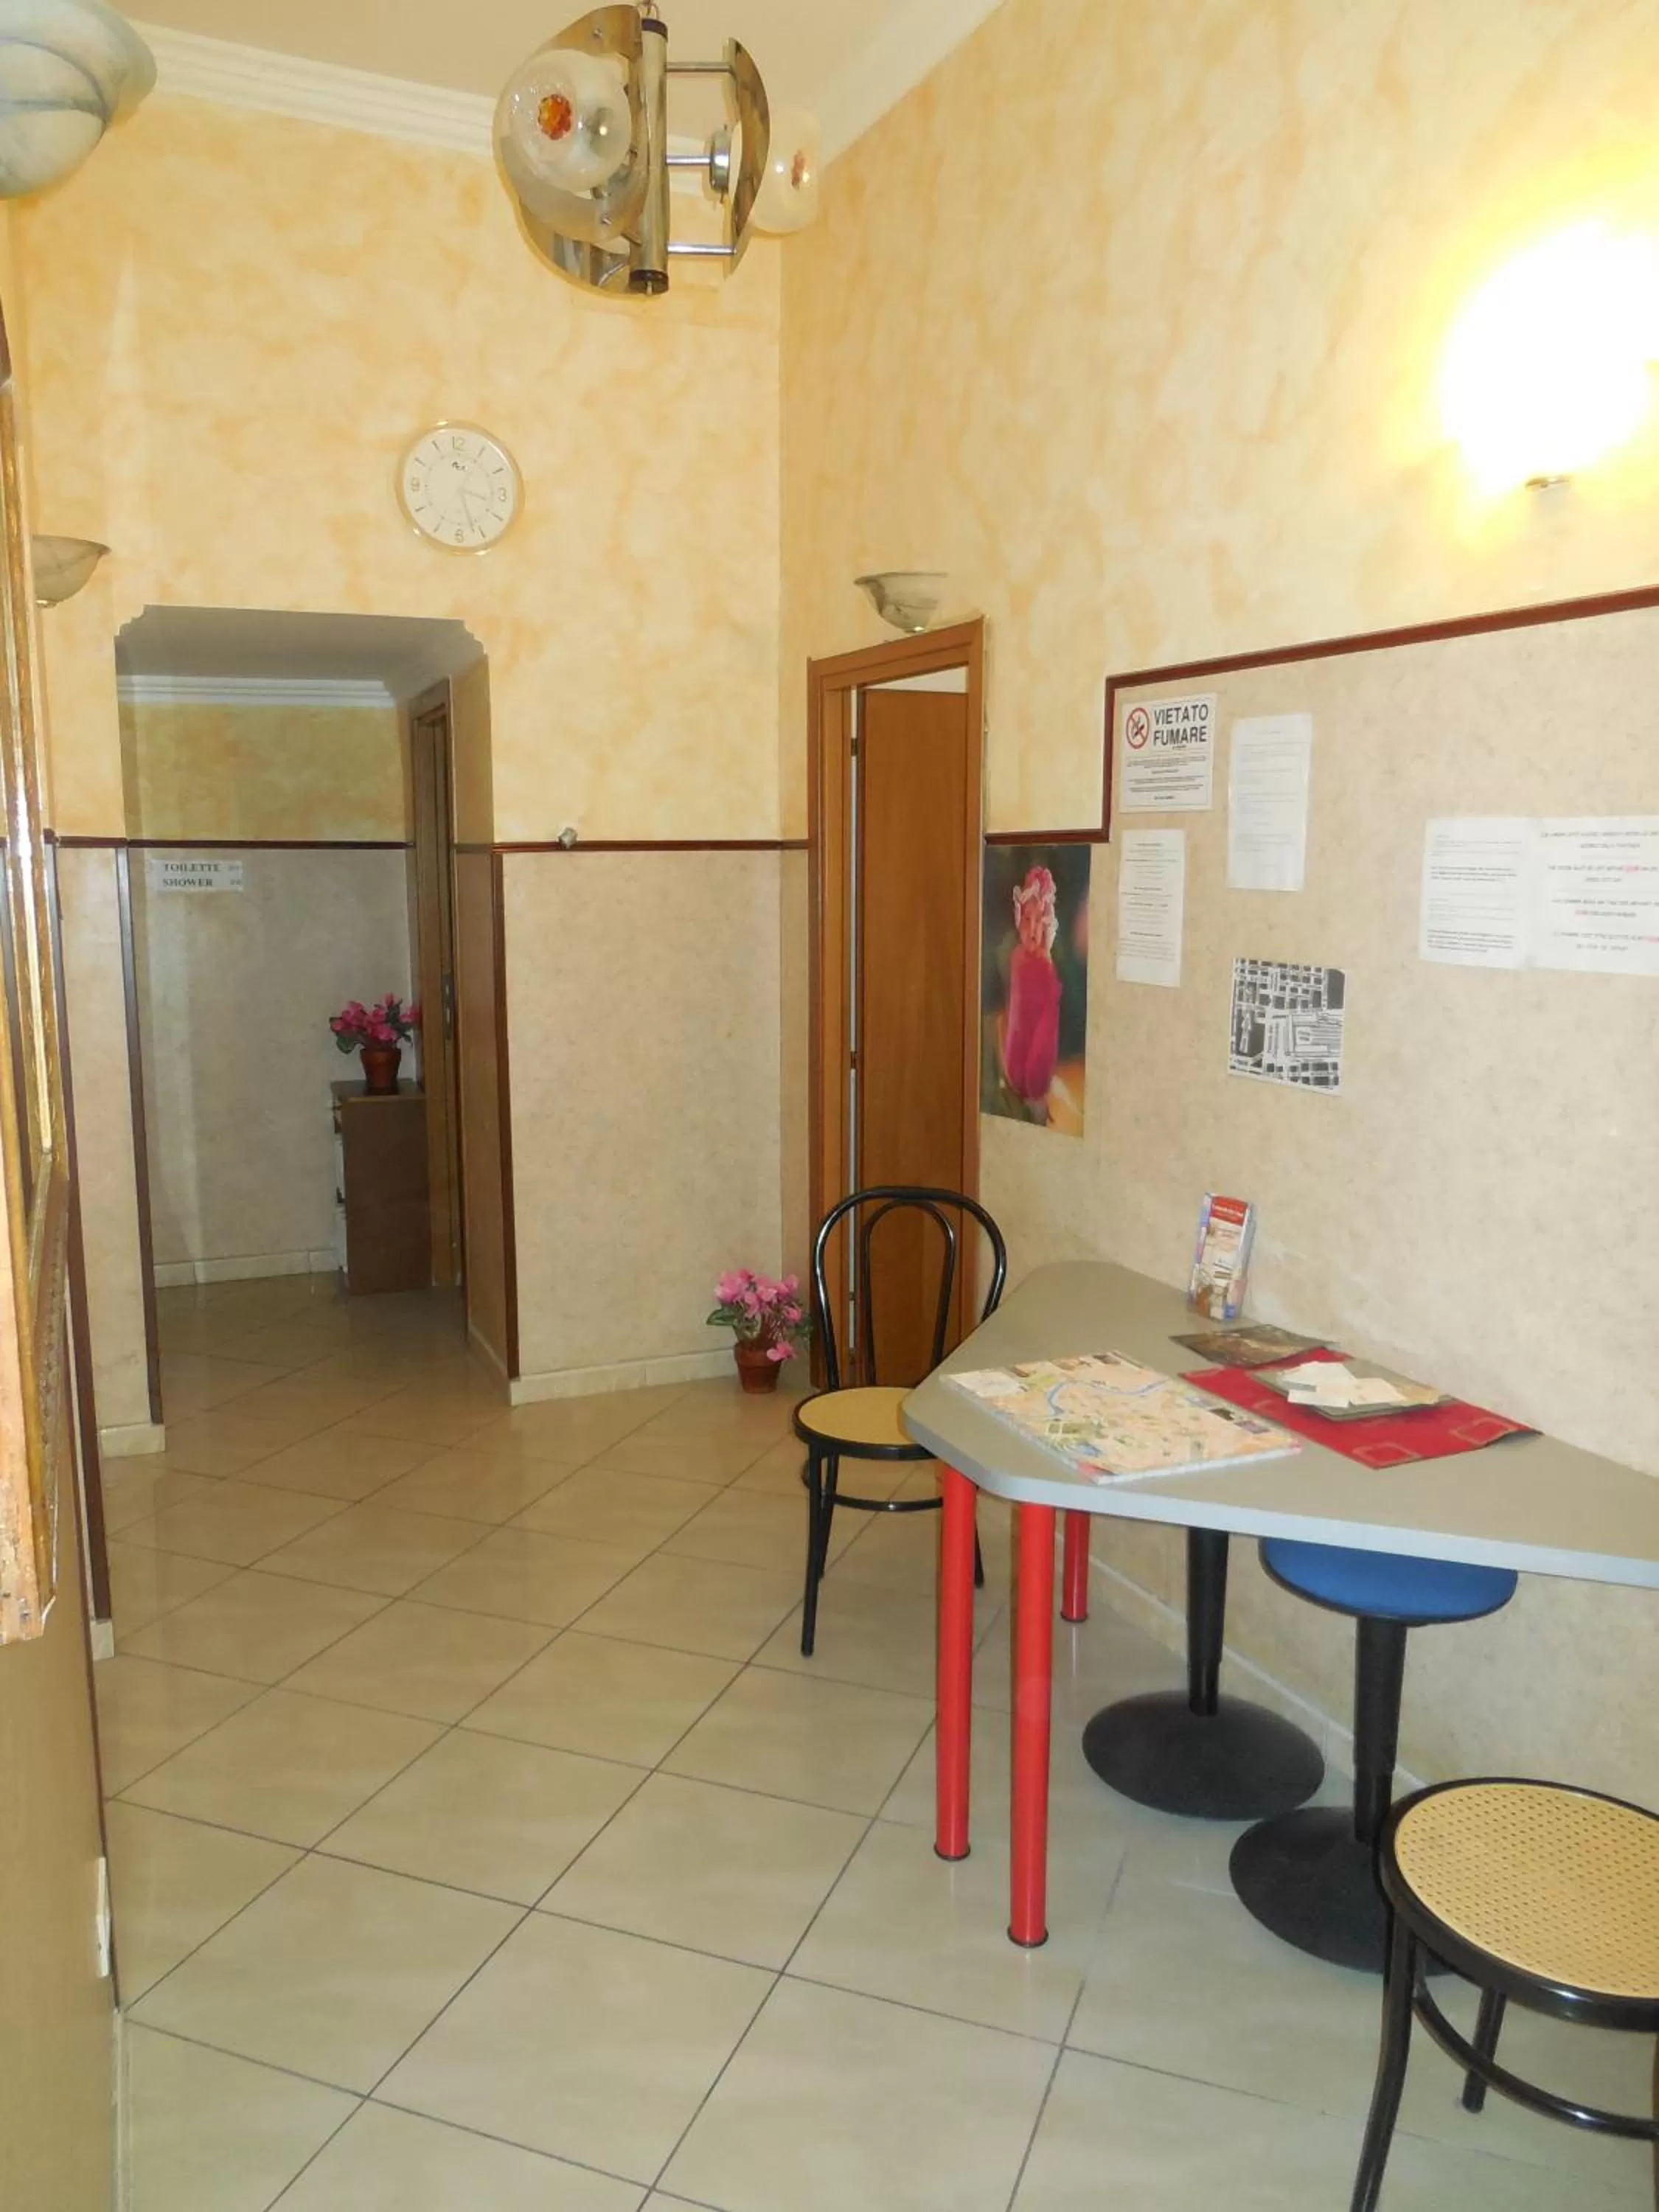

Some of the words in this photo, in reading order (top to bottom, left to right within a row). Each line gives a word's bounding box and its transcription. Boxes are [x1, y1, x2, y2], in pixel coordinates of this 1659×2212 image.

[452, 436, 467, 451] 12
[497, 487, 507, 502] 3
[453, 528, 465, 543] 6
[1154, 703, 1208, 726] VIETATO
[1152, 726, 1208, 747] FUMARE
[164, 863, 220, 872] TOILETTE
[162, 878, 214, 887] SHOWER
